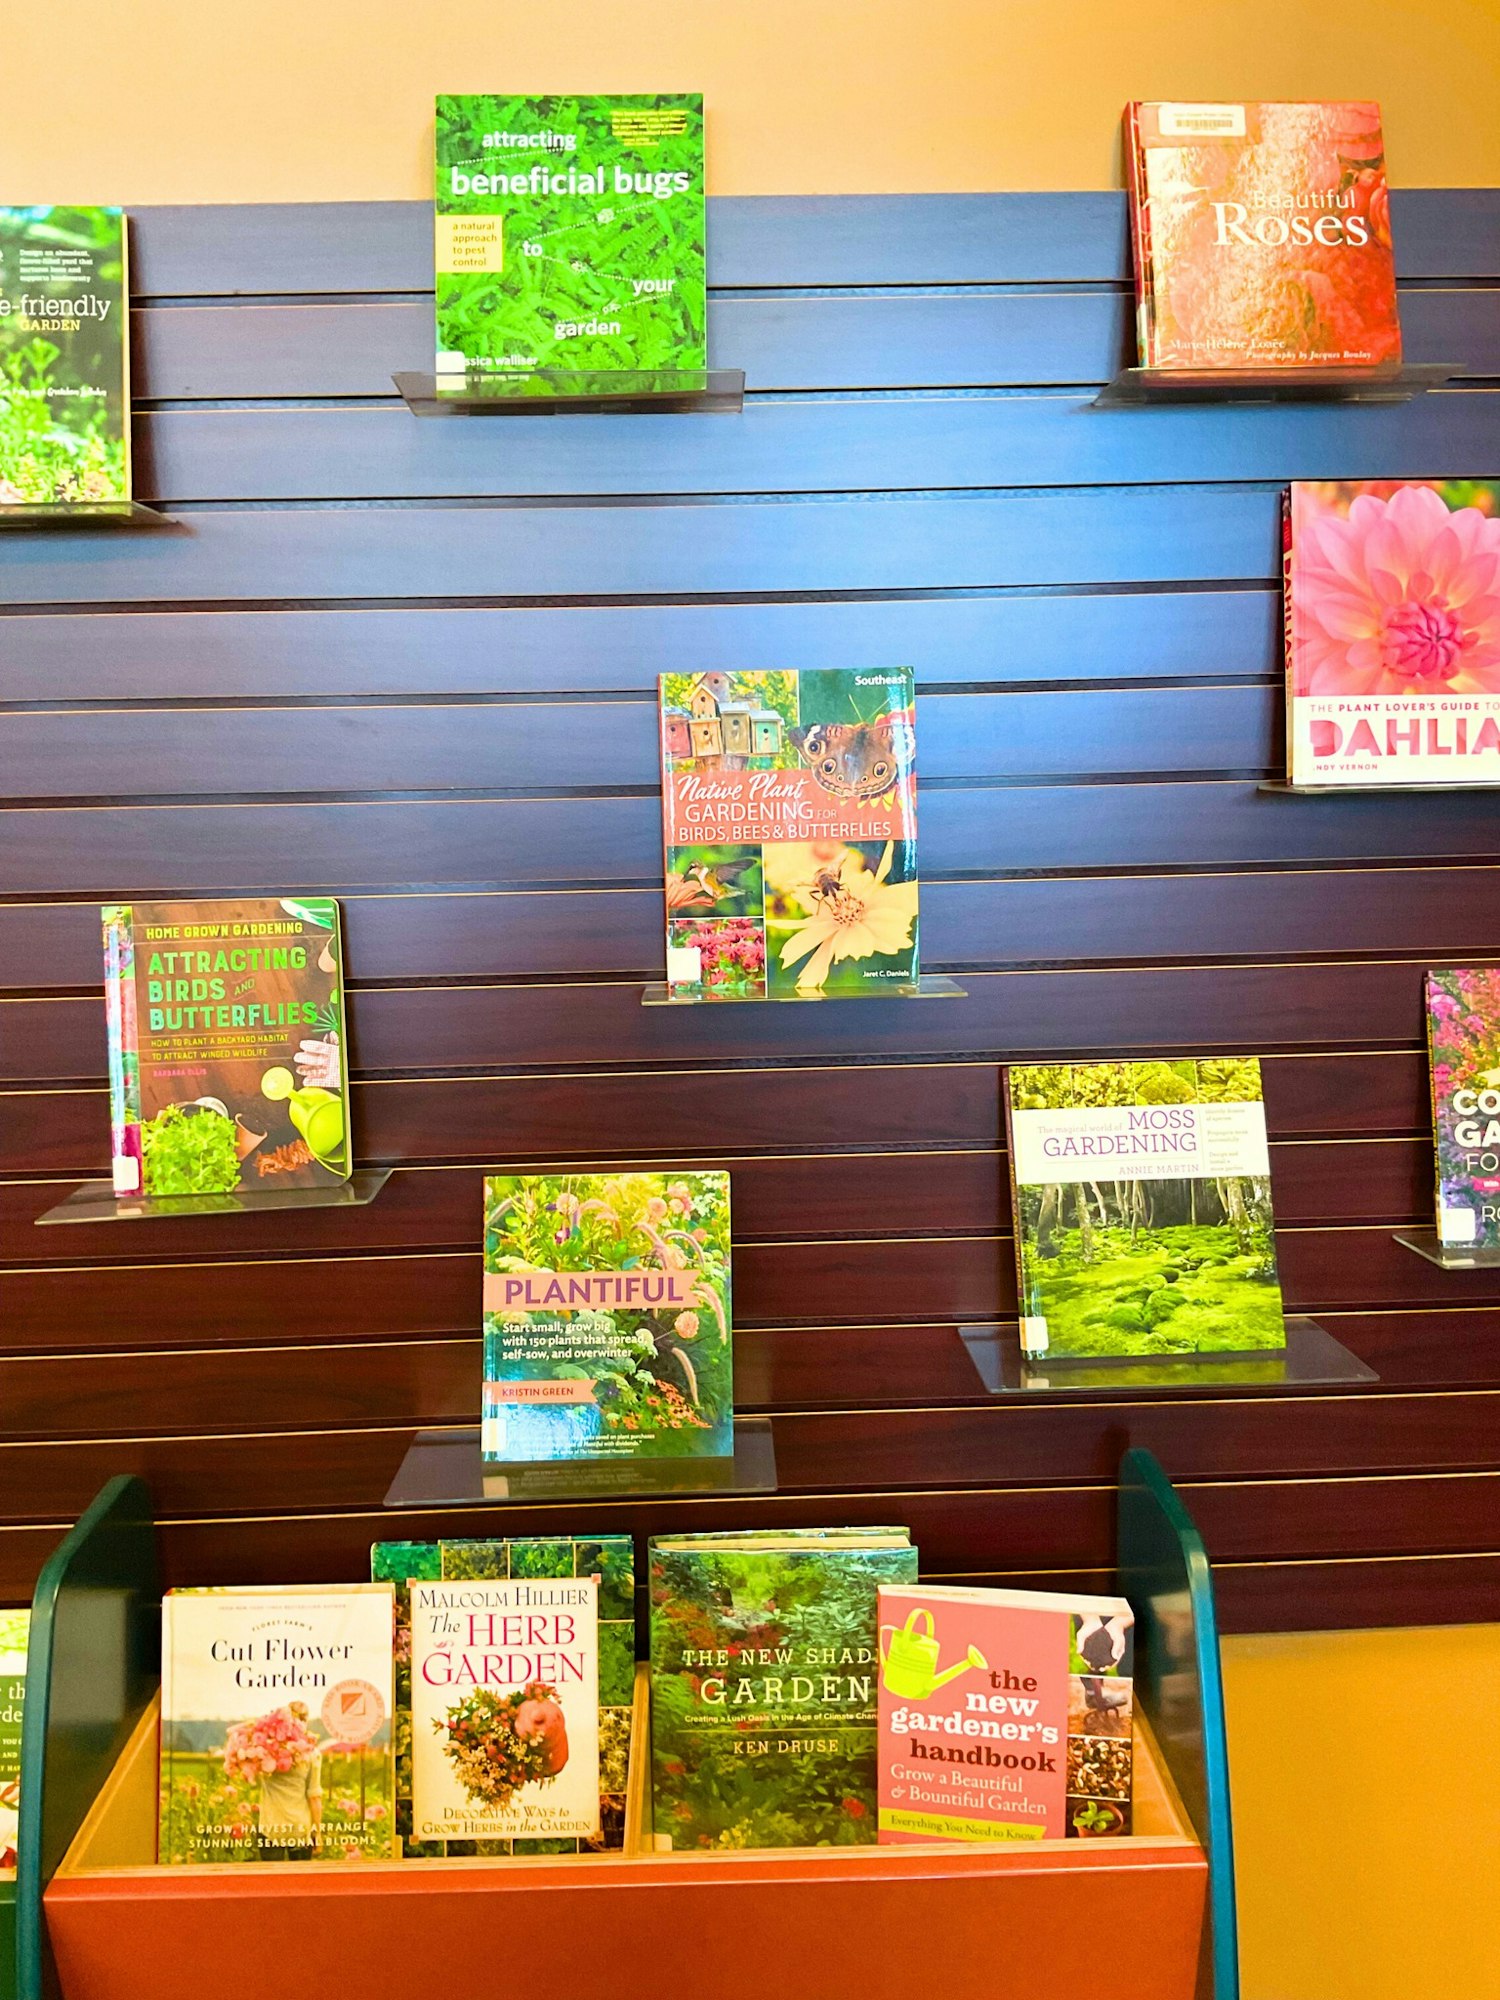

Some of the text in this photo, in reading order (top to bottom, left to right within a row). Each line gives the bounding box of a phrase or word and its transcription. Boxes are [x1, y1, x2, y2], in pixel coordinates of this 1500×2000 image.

[482, 130, 577, 151] attracting
[451, 166, 690, 199] beneficial bugs
[1253, 188, 1356, 209] Beautiful
[452, 221, 495, 230] a natural
[1210, 202, 1368, 247] Roses
[452, 234, 497, 245] approach
[522, 240, 543, 257] to
[452, 246, 486, 256] to pest
[452, 257, 487, 266] control
[632, 279, 676, 296] your
[20, 319, 81, 331] GARDEN
[554, 318, 621, 340] garden
[854, 675, 907, 686] Southeast
[1310, 701, 1500, 713] THE PLANT LOVER'S GUIDE TO
[1310, 718, 1500, 757] DAHLIA
[678, 773, 811, 801] Native Plant
[685, 801, 837, 823] GARDENING FOR
[679, 822, 892, 842] BIRDS, BEES & BUTTERFLIES
[146, 922, 303, 940] HOME GROWN GARDENING
[148, 947, 307, 976] ATTRACTING
[886, 969, 910, 978] Daniels
[148, 977, 256, 1003] BIRDS AND
[149, 1002, 318, 1031] BUTTERFLIES
[151, 1033, 289, 1047] HOW TO PLANT A BACKYARD HABITAT
[152, 1048, 268, 1061] TO ATTRACT WINGED WILDLIFE
[1038, 1125, 1054, 1134] The
[1055, 1124, 1088, 1135] magical
[1090, 1123, 1112, 1133] world
[1113, 1122, 1123, 1132] of
[1128, 1109, 1196, 1131] MOSS
[1044, 1132, 1197, 1157] GARDENING
[1119, 1164, 1200, 1176] ANNIE MARTIN
[505, 1277, 684, 1305] PLANTIFUL
[503, 1320, 611, 1335] Start small, grow big
[502, 1334, 648, 1348] with 150 plants that spread,
[502, 1347, 633, 1360] self-sow, and overwinter
[502, 1387, 574, 1398] KRISTIN GREEN
[418, 1586, 589, 1609] MALCOLM HILLIER
[429, 1613, 576, 1647] The HERB
[211, 1638, 353, 1662] Cut Flower
[683, 1649, 729, 1667] THE
[741, 1648, 794, 1666] NEW
[235, 1665, 326, 1688] Garden
[422, 1651, 587, 1686] GARDEN
[700, 1675, 871, 1704] GARDEN
[989, 1670, 1038, 1692] the
[966, 1692, 1039, 1717] new
[684, 1715, 719, 1724] Creating
[727, 1714, 746, 1722] Lush
[748, 1714, 770, 1722] Oasis
[781, 1713, 795, 1721] the
[796, 1713, 812, 1722] Age
[813, 1712, 823, 1720] of
[823, 1712, 854, 1720] Climate
[890, 1706, 1059, 1744] gardener's
[2, 1751, 18, 1759] AND
[734, 1738, 839, 1755] KEN DRUSE
[909, 1738, 1057, 1773] handbook
[890, 1763, 1023, 1794] Grow a Beautiful
[891, 1785, 1048, 1816] & Bountiful Garden
[523, 1805, 556, 1818] WAYS
[559, 1807, 570, 1817] to
[196, 1824, 237, 1835] GROW,
[240, 1823, 293, 1834] HARVEST
[311, 1821, 368, 1833] ARRANGE
[422, 1818, 591, 1834] GROW HERBS in the GARDEN
[890, 1814, 943, 1834] Everything
[944, 1821, 963, 1833] You
[965, 1824, 991, 1837] Need
[993, 1829, 1004, 1838] to
[189, 1835, 376, 1849] STUNNING SEASONAL BLOOMS
